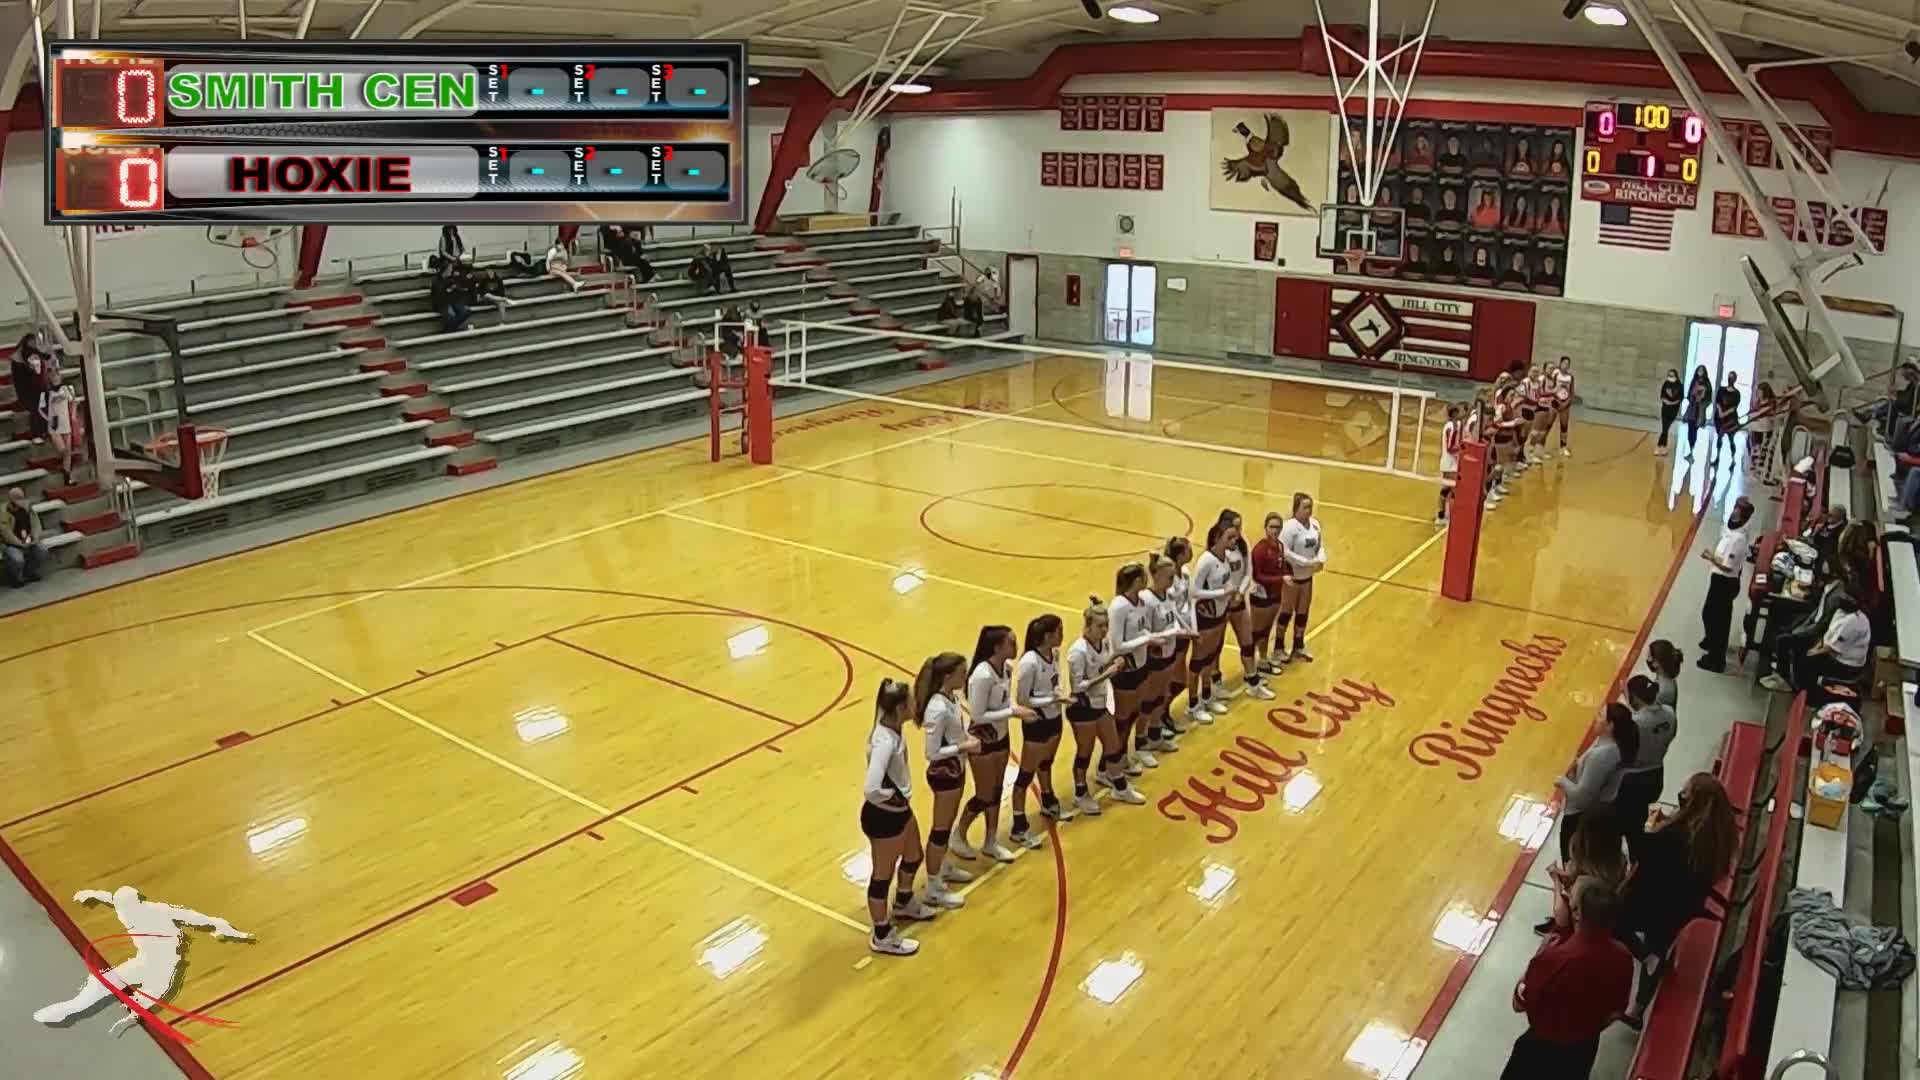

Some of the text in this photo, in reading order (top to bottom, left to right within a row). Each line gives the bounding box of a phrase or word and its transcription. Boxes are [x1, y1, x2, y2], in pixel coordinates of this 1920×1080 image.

[1599, 111, 1614, 135] 0
[1685, 116, 1702, 143] 0
[1587, 150, 1600, 173] 0
[1647, 155, 1655, 177] 1
[1682, 158, 1697, 181] 0
[1615, 188, 1696, 206] RINGNECKS
[1402, 298, 1461, 313] HILL CITY
[1393, 352, 1461, 369] RINGNECKS
[1408, 633, 1567, 782] Ringnecks
[1157, 678, 1396, 844] Hill City
